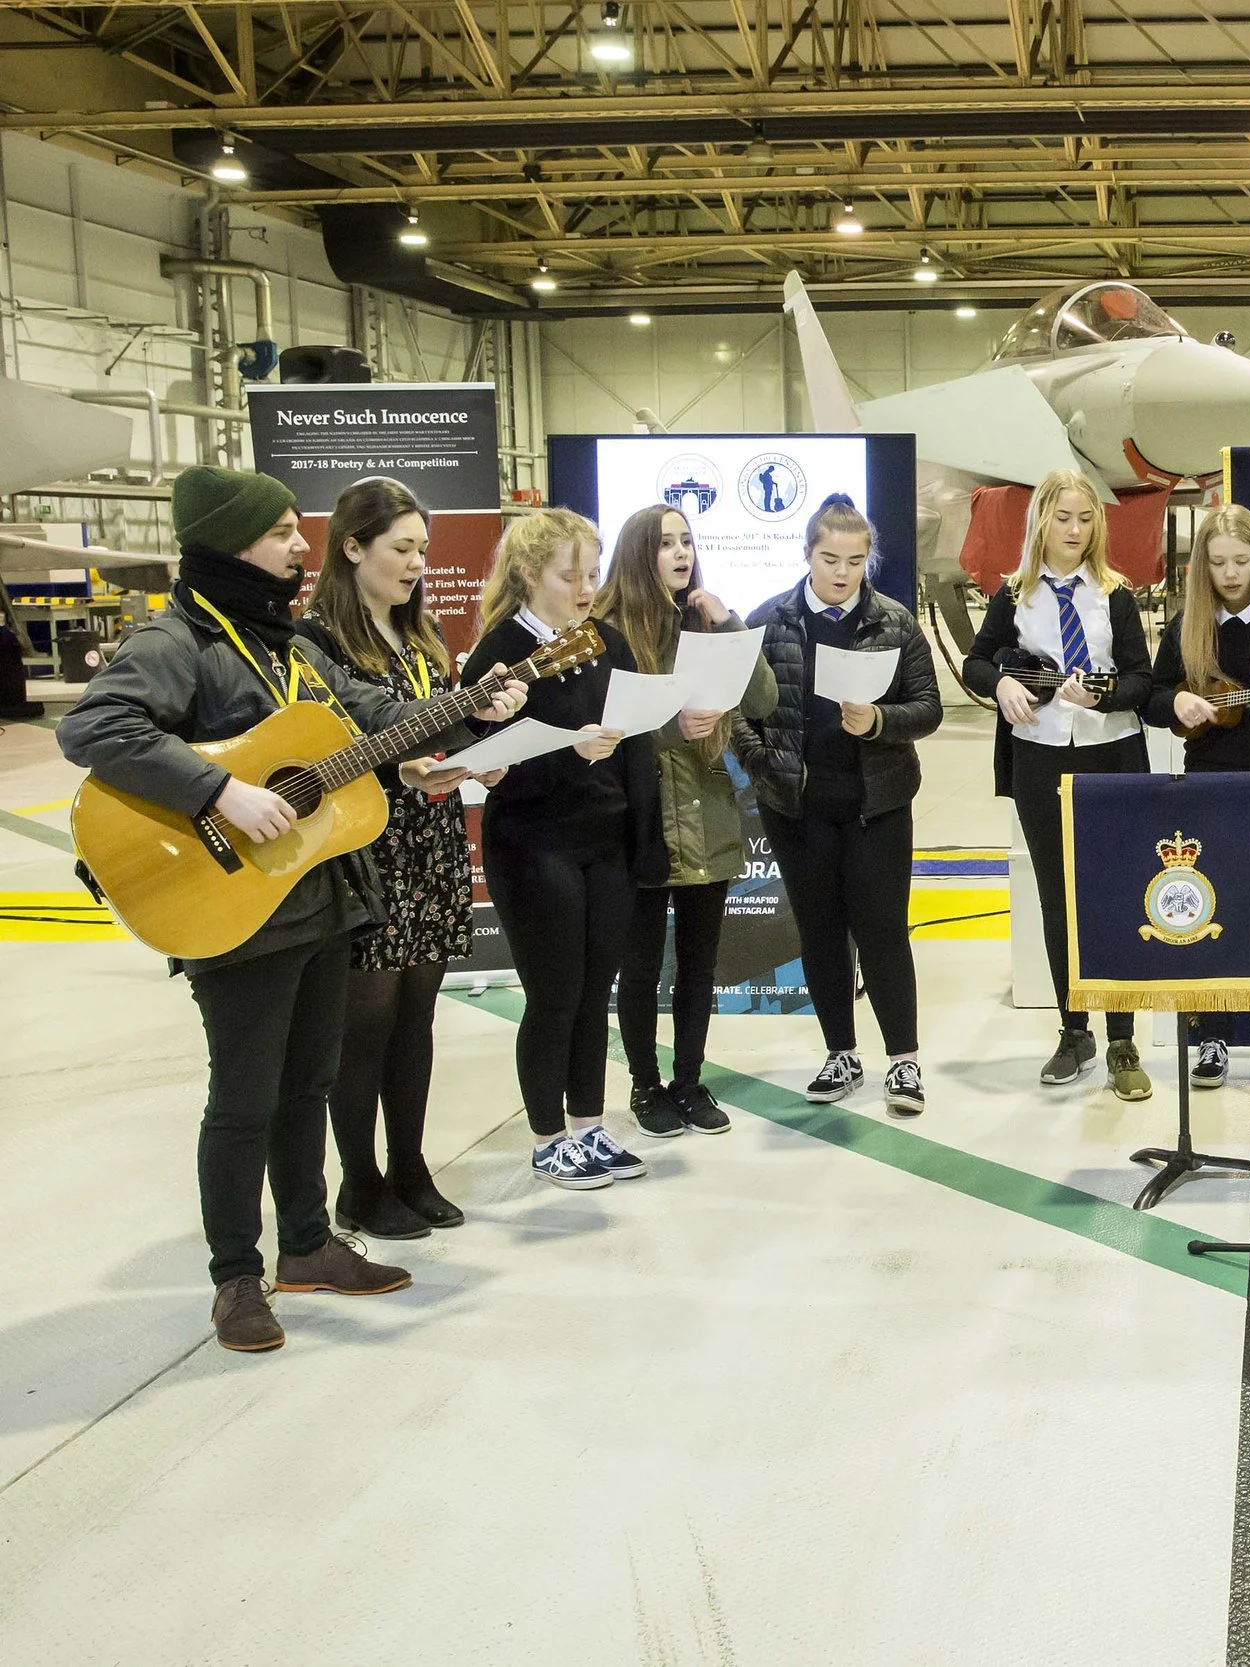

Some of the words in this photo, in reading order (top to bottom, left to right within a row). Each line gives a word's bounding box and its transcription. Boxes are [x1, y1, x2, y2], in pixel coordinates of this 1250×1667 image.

[277, 410, 330, 425] Never
[334, 409, 377, 425] Such
[381, 409, 468, 425] Innocence
[291, 460, 328, 470] 2017-18
[331, 459, 363, 471] Poetry
[367, 459, 375, 468] &
[378, 459, 394, 468] Art
[396, 458, 459, 470] Competition
[773, 533, 806, 541] Roadsh
[456, 567, 466, 575] to
[435, 580, 456, 589] First
[457, 579, 486, 588] World
[440, 594, 468, 604] poetry
[435, 607, 467, 617] period.
[743, 896, 779, 904] #RAF100
[728, 907, 776, 915] INSTAGRAM
[745, 986, 797, 995] CELEBRATE.
